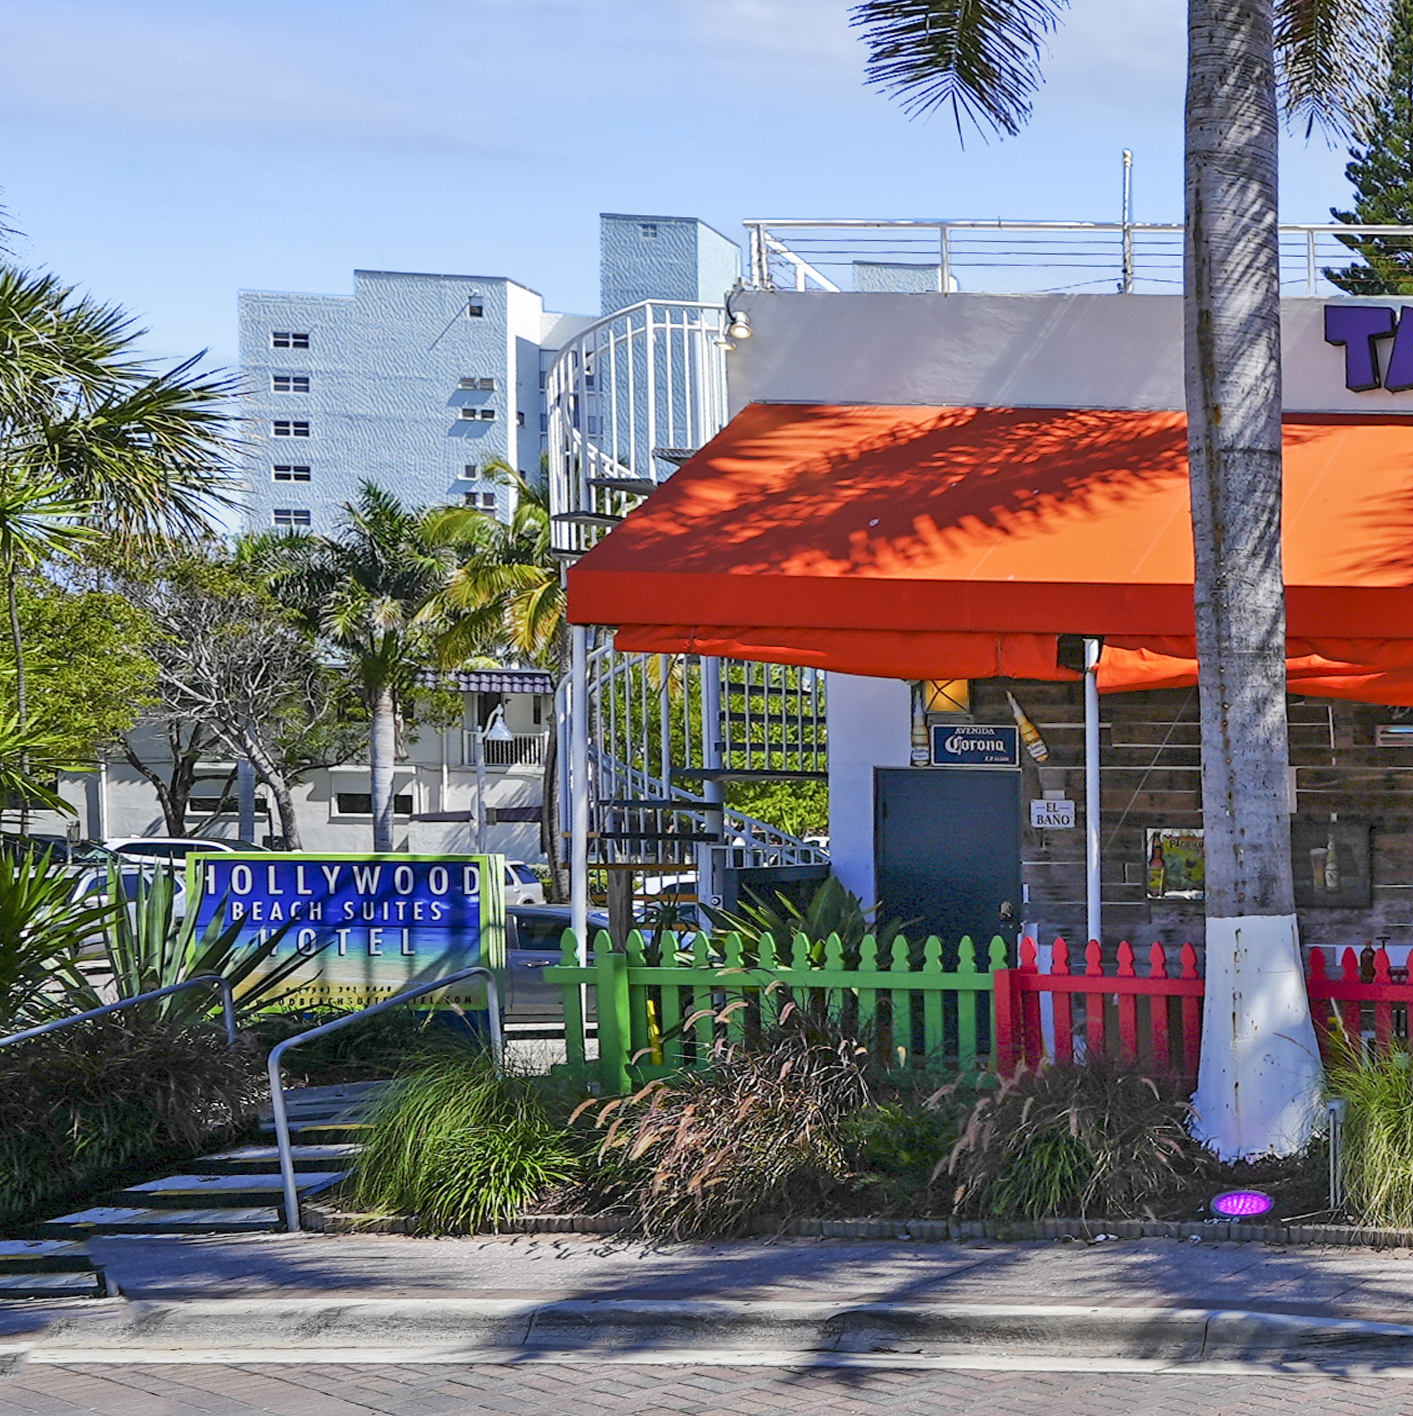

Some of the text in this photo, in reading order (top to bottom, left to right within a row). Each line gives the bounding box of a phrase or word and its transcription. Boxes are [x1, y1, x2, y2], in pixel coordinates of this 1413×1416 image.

[954, 727, 996, 735] AVENIDA
[945, 735, 1007, 755] Corona
[1046, 802, 1059, 813] EL
[1036, 813, 1070, 826] BAÑO
[195, 864, 480, 895] HOLLYWOOD
[231, 901, 442, 921] BEACH SUITES
